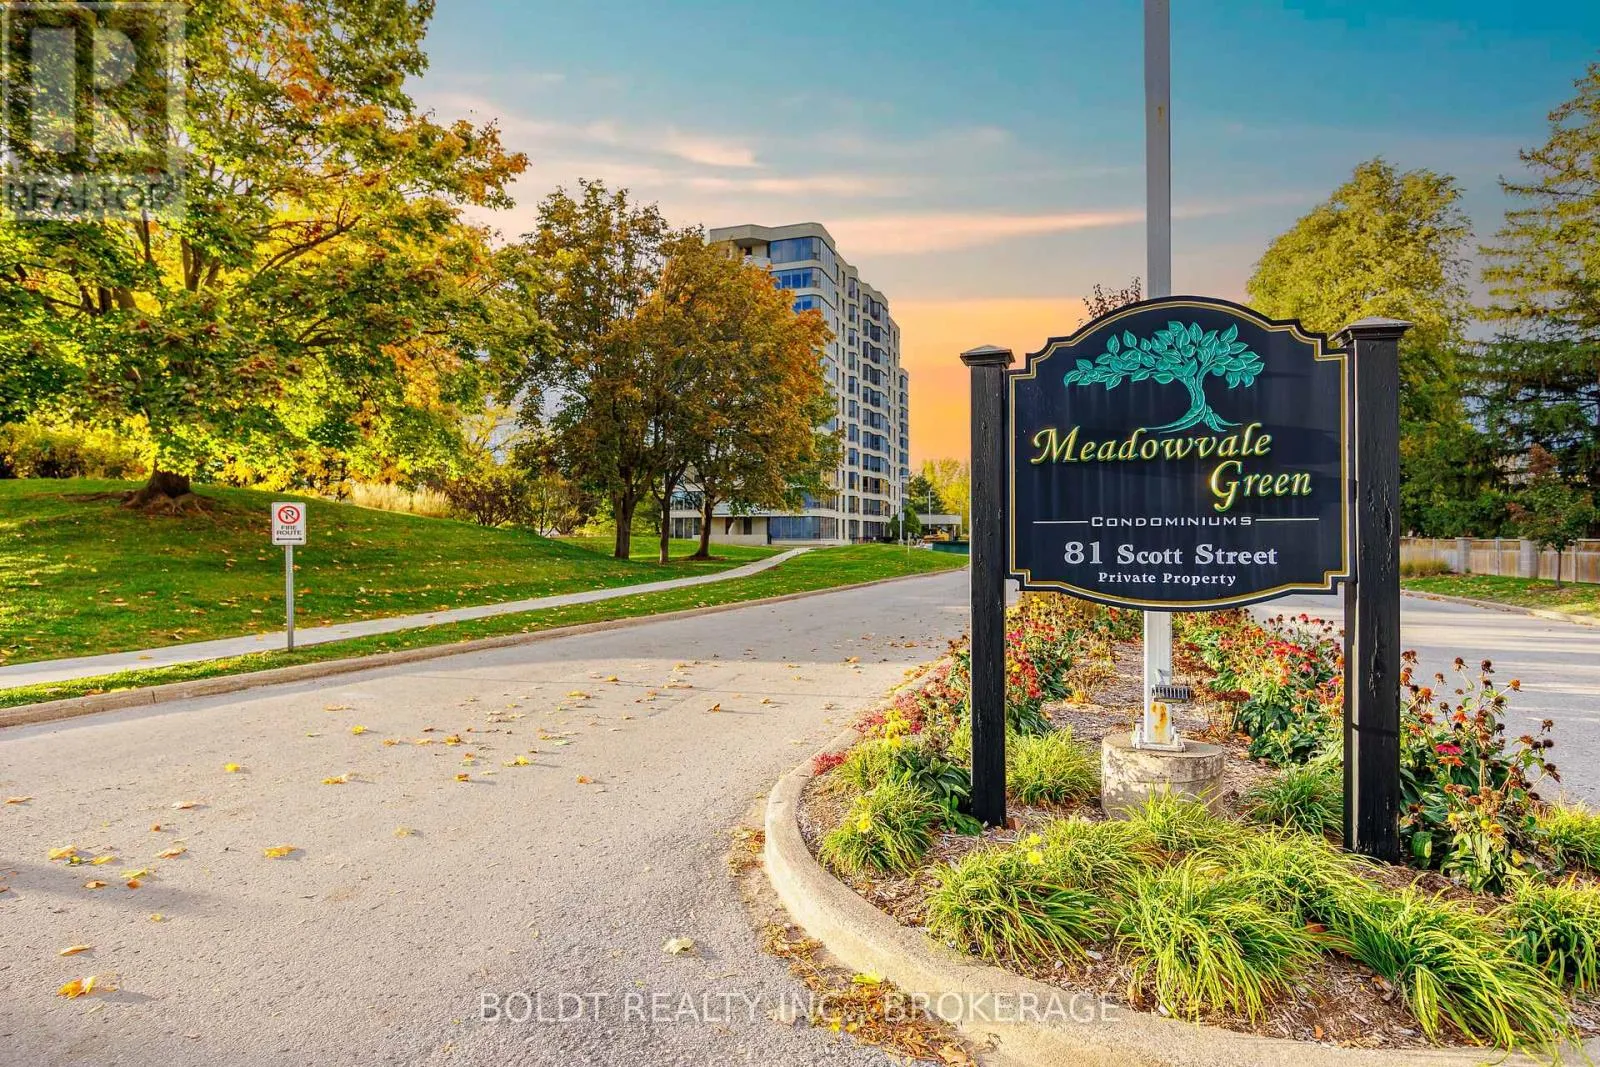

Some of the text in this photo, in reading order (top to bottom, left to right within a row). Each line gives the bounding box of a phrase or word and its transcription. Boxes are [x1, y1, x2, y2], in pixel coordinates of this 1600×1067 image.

[1030, 422, 1273, 465] Meadowvale
[1209, 460, 1312, 512] Green
[1064, 541, 1278, 565] 81 Scott Street
[1098, 572, 1236, 587] Private Property
